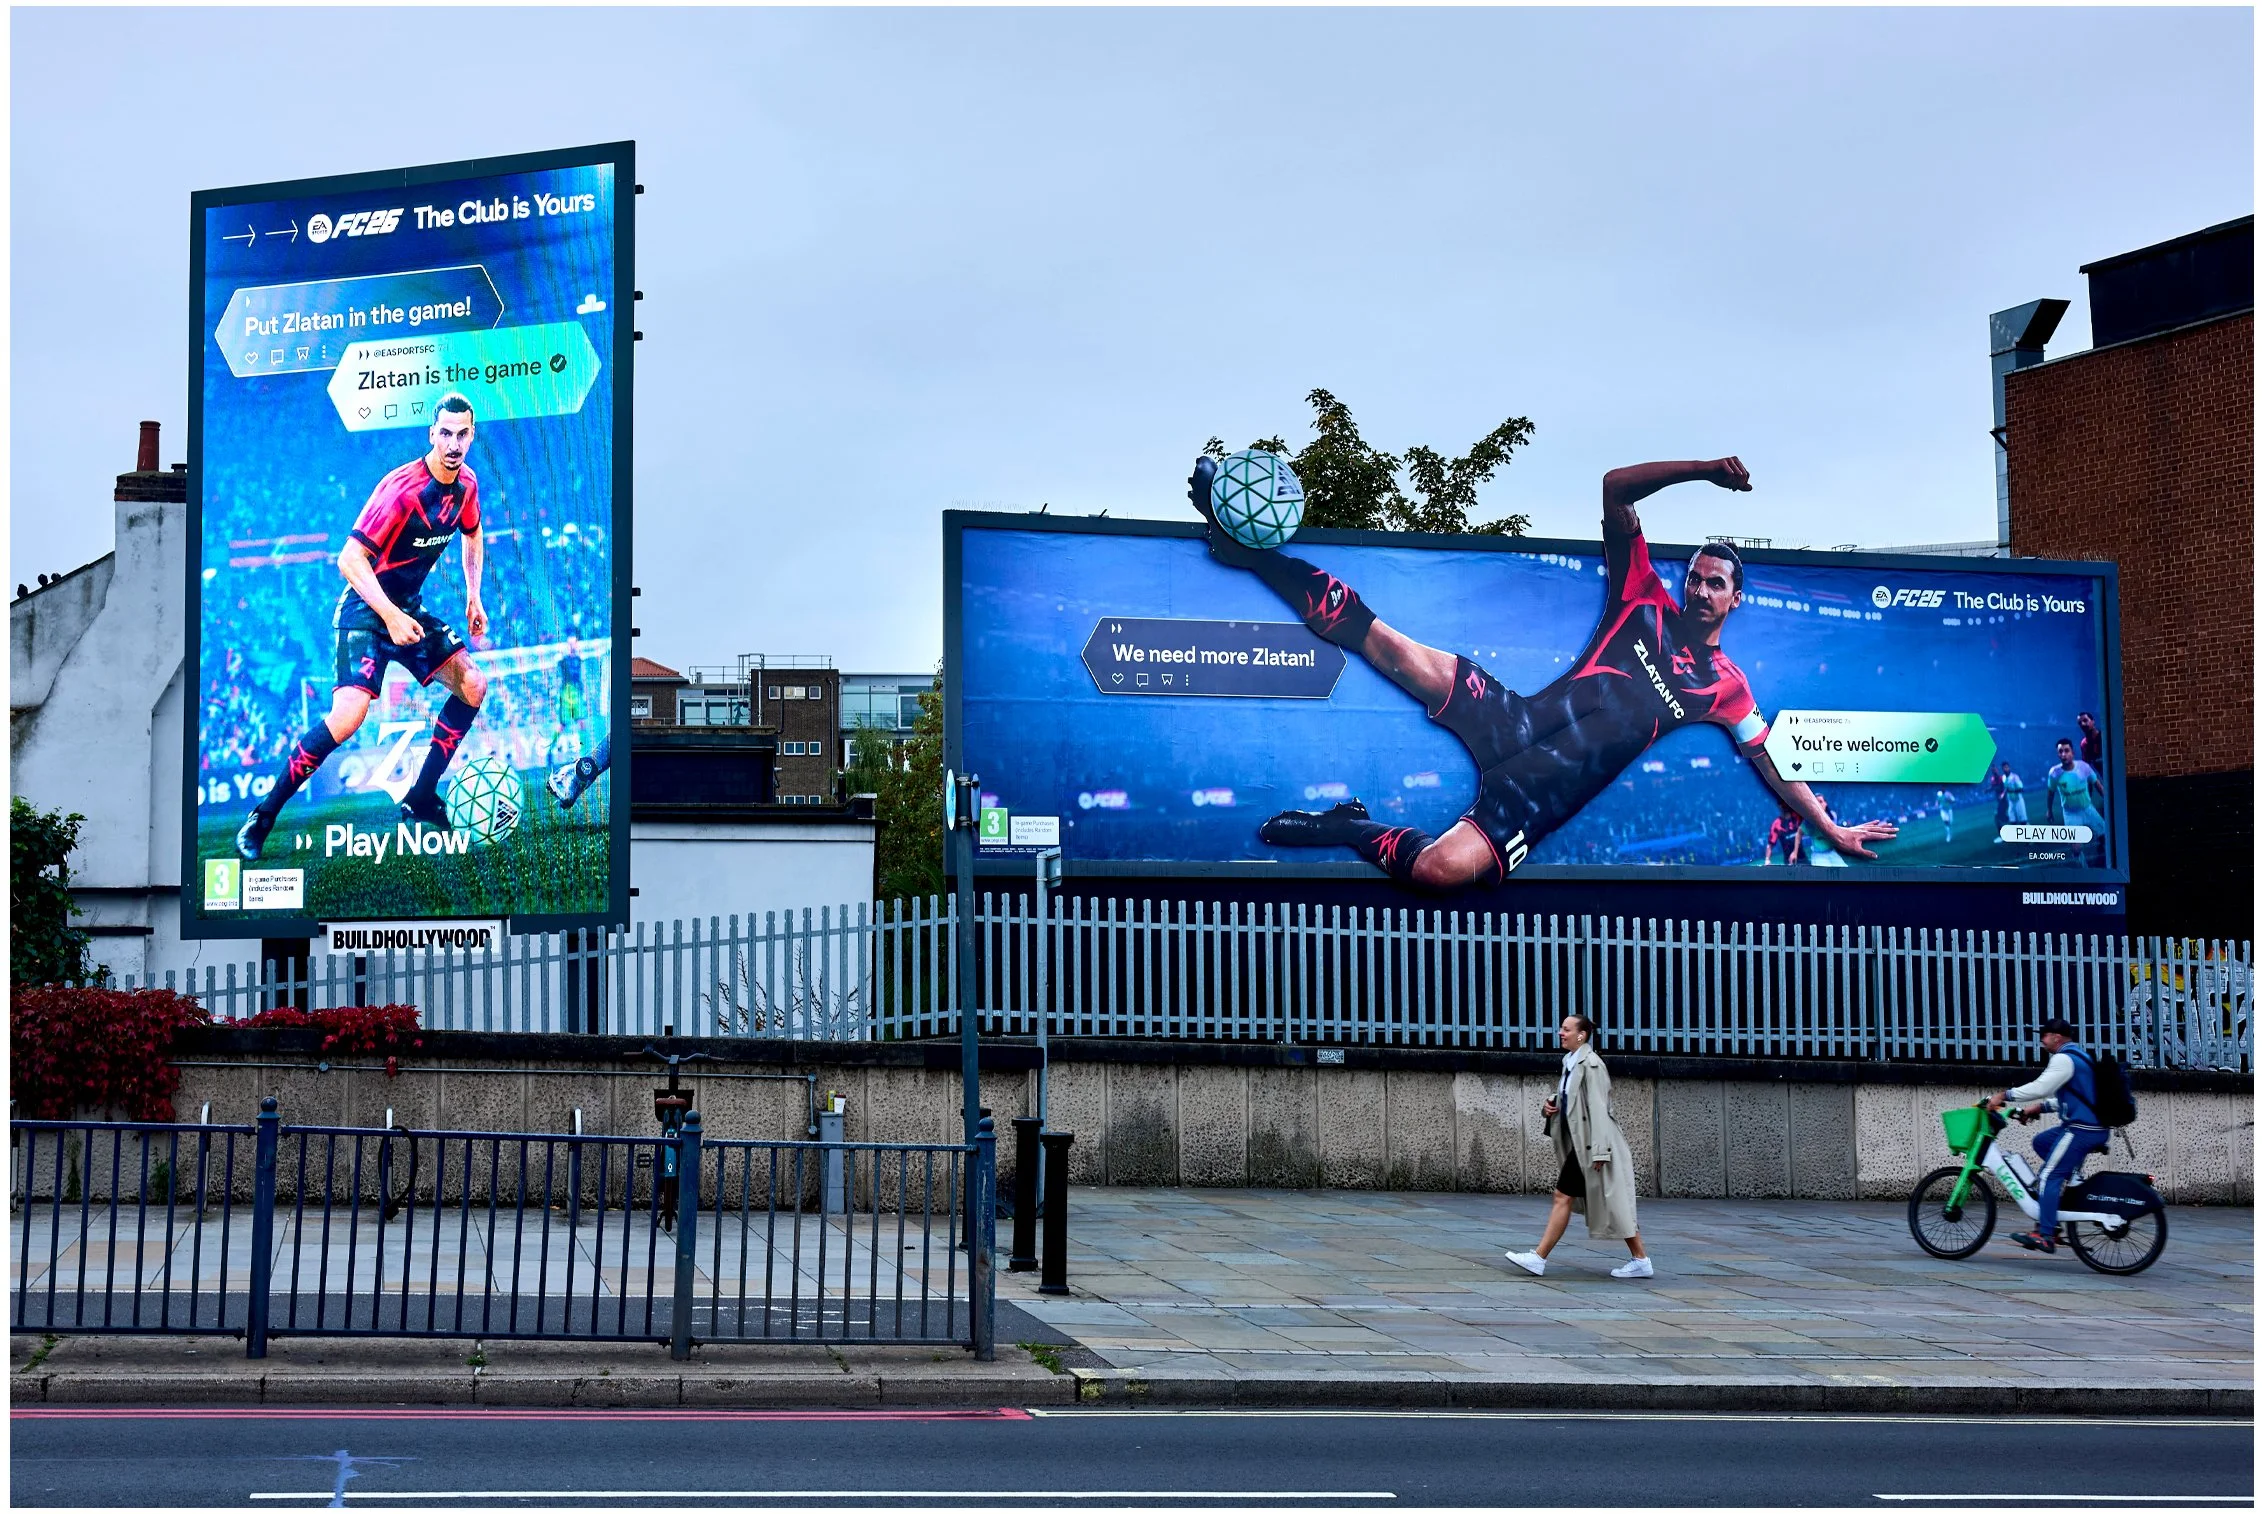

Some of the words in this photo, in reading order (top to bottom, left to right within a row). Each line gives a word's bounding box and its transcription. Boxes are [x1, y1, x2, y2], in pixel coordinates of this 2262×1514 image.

[331, 208, 404, 239] FC26
[414, 204, 454, 229] The
[458, 197, 508, 225] Club
[513, 195, 530, 219] is
[533, 192, 595, 216] Yours
[245, 316, 279, 337] Put
[283, 312, 344, 334] Zlatan
[349, 307, 366, 328] in
[371, 304, 404, 325] the
[409, 295, 471, 327] game!
[373, 344, 435, 358] @EASPORTSFC
[358, 370, 420, 390] Zlatan
[425, 365, 440, 385] is
[447, 362, 479, 383] the
[485, 360, 541, 384] game
[1891, 588, 1946, 608] FC26
[1953, 591, 1984, 609] The
[1987, 592, 2023, 611] Club
[2026, 594, 2039, 612] is
[2041, 595, 2085, 614] Yours
[1112, 643, 1144, 662] We
[1149, 646, 1196, 664] need
[1200, 652, 1249, 666] more
[1252, 648, 1315, 667] Zlatan!
[1633, 639, 1673, 704] ZLATAN
[1668, 698, 1685, 719] FC
[1791, 735, 1843, 751] You're
[1848, 736, 1920, 753] welcome
[987, 811, 1000, 835] 3
[2016, 827, 2046, 840] PLAY
[2051, 828, 2076, 840] NOW
[325, 823, 391, 865] Play
[396, 822, 471, 856] Now
[2028, 852, 2066, 860] EA.COM/FC
[214, 863, 230, 896] 3
[2022, 891, 2118, 905] BUILDHOLLYWOOD
[333, 928, 491, 950] BUILDHOLLYWOOD
